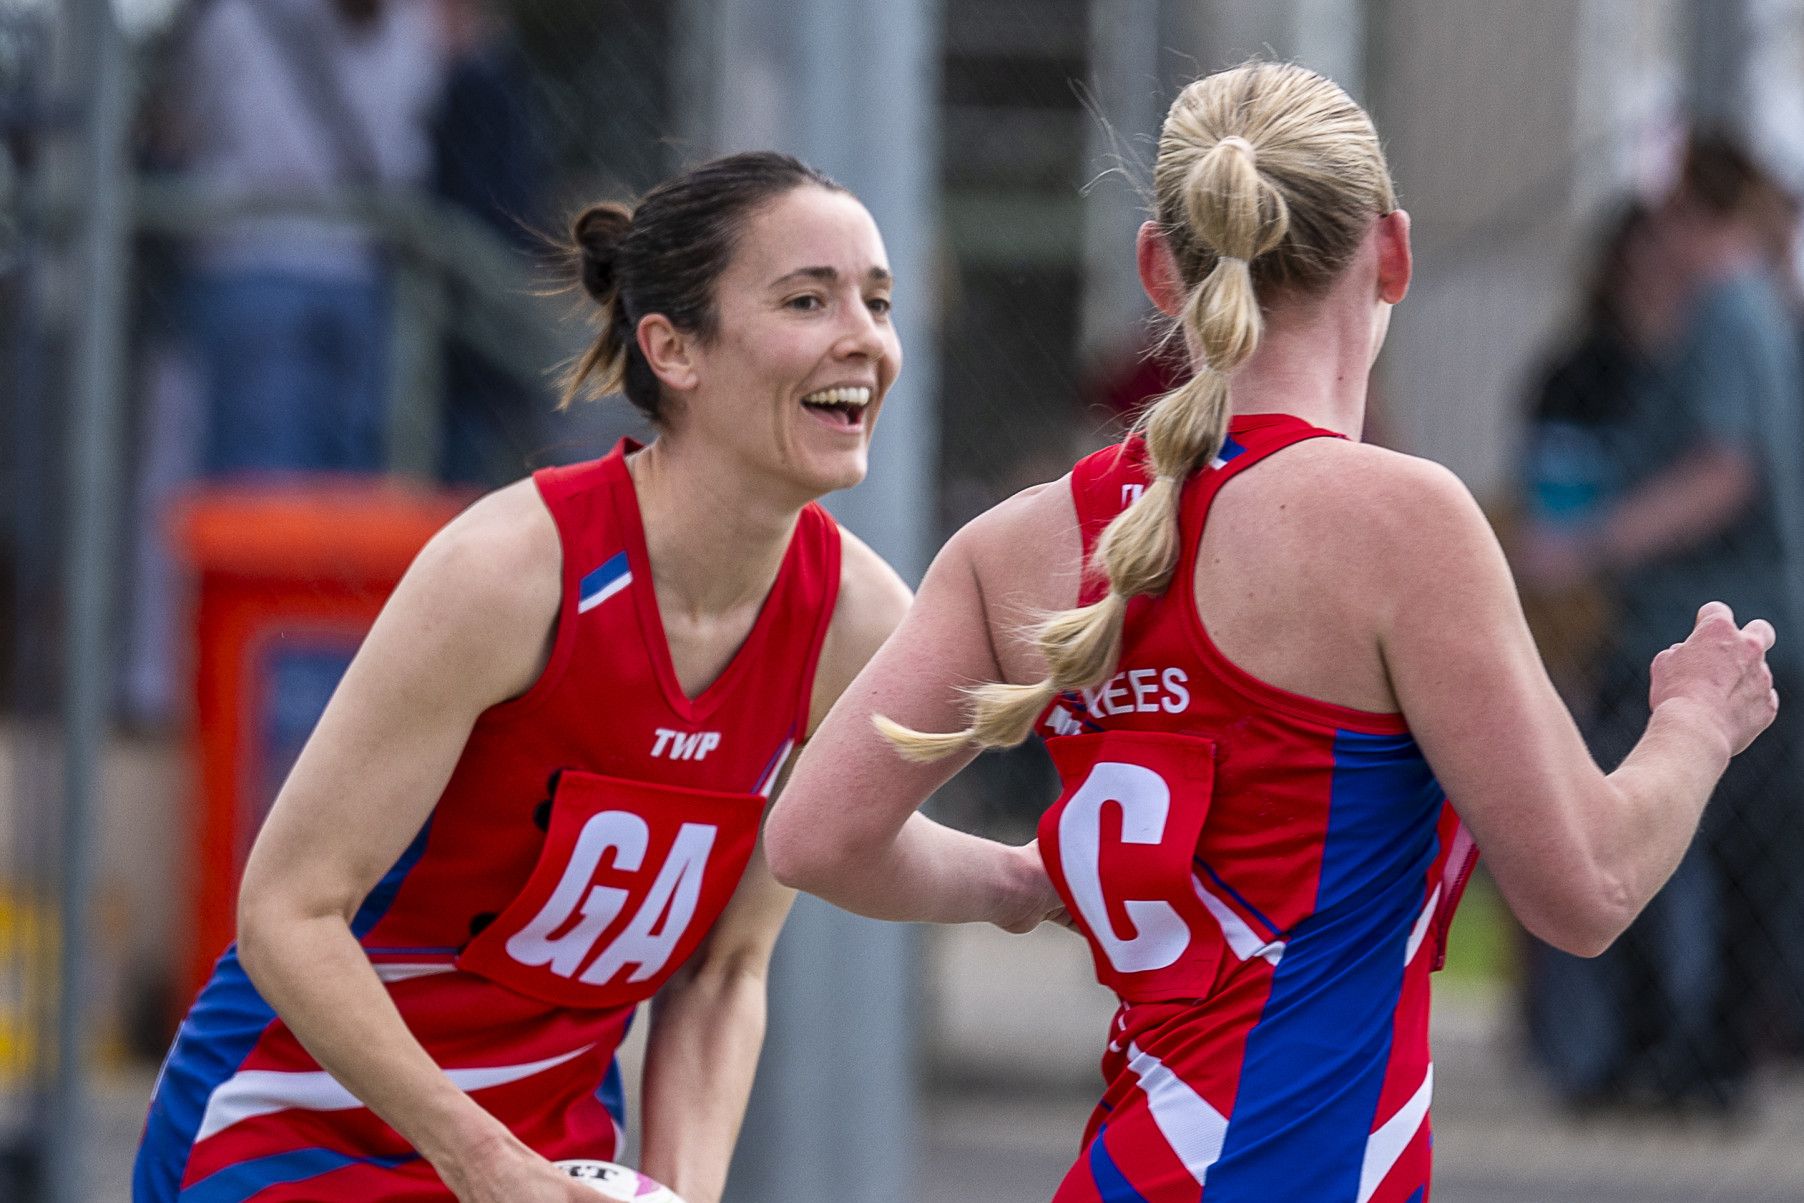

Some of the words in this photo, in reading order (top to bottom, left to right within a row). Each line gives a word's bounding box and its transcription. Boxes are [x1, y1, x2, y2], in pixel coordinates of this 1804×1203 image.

[650, 727, 721, 761] TWP
[505, 810, 718, 986] GA
[1058, 762, 1191, 973] C
